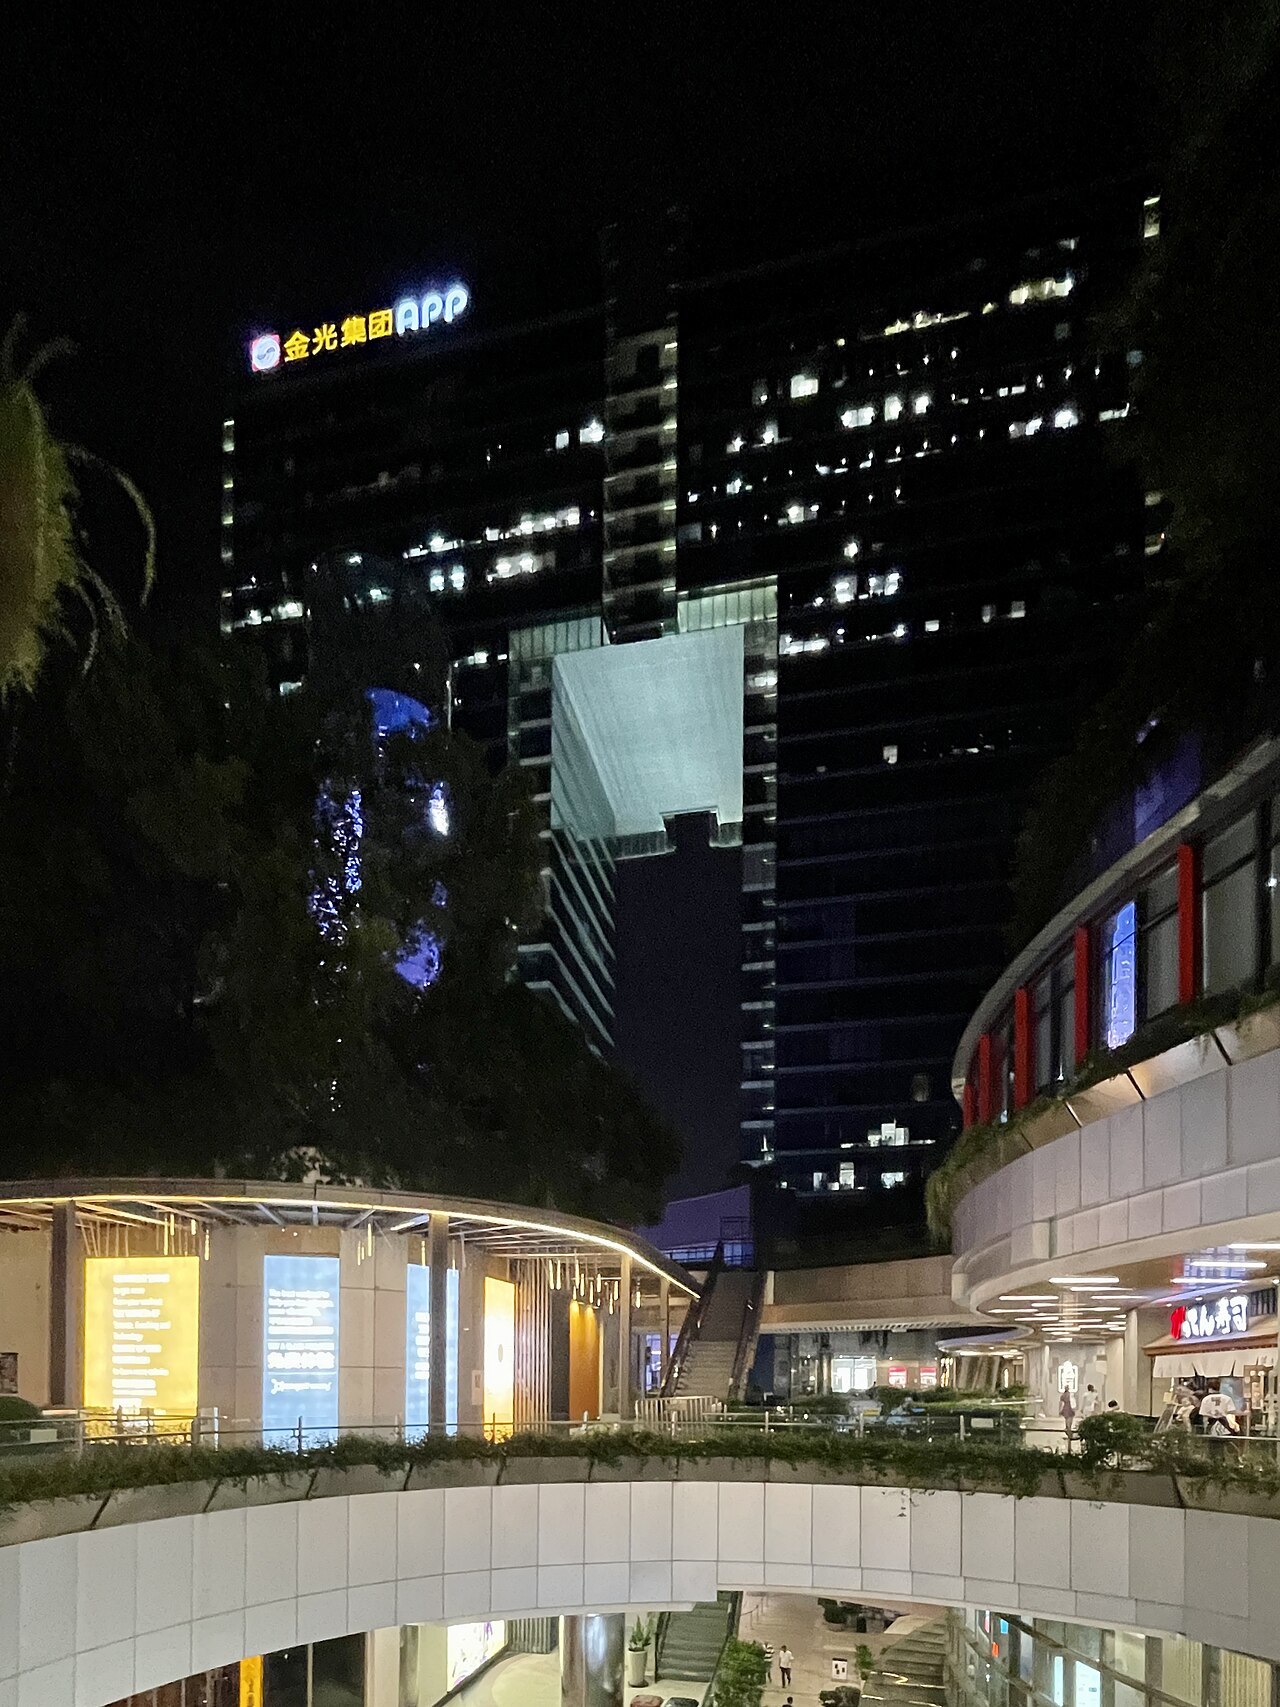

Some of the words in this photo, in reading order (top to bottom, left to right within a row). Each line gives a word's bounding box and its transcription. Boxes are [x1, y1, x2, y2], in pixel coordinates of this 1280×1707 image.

[284, 308, 393, 362] 金光集团
[397, 287, 468, 336] APP
